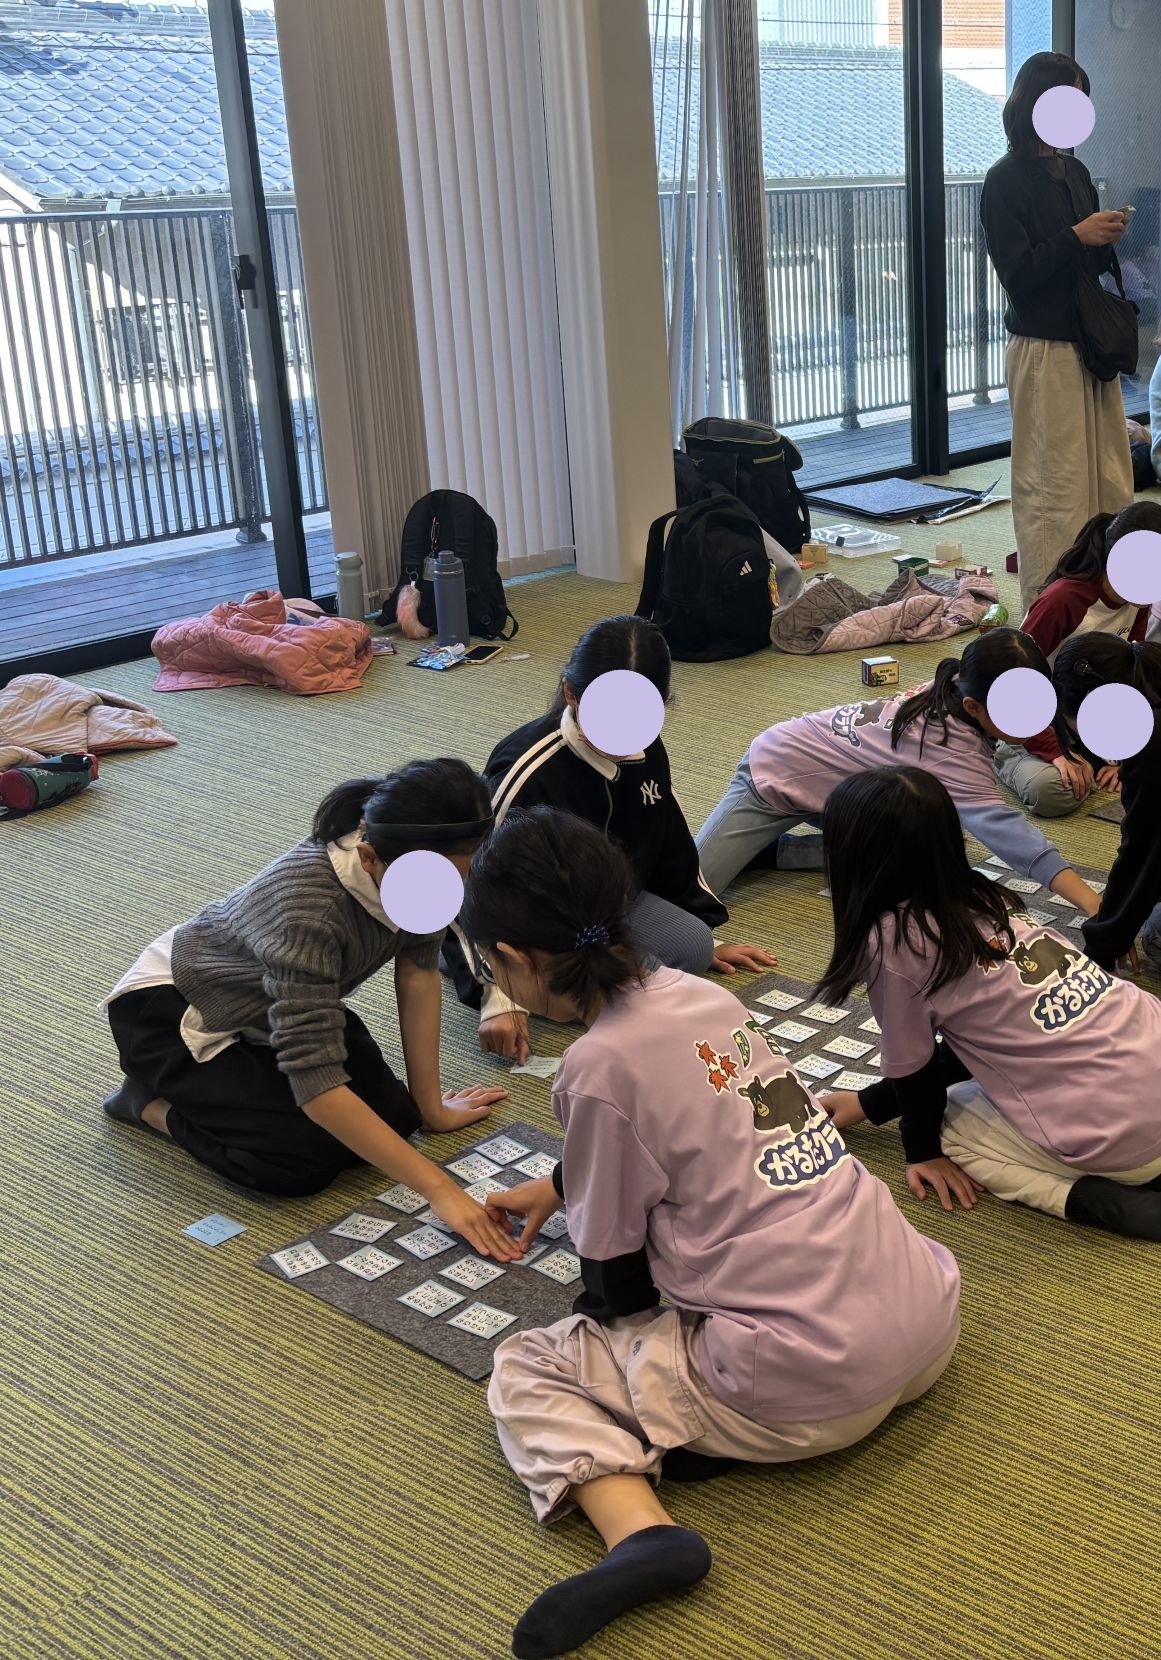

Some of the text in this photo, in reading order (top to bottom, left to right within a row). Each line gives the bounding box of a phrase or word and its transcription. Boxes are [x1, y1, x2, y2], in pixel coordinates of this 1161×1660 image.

[640, 779, 662, 805] NY
[1040, 960, 1110, 1024] かるたクラ
[767, 1122, 846, 1181] かるたクラ
